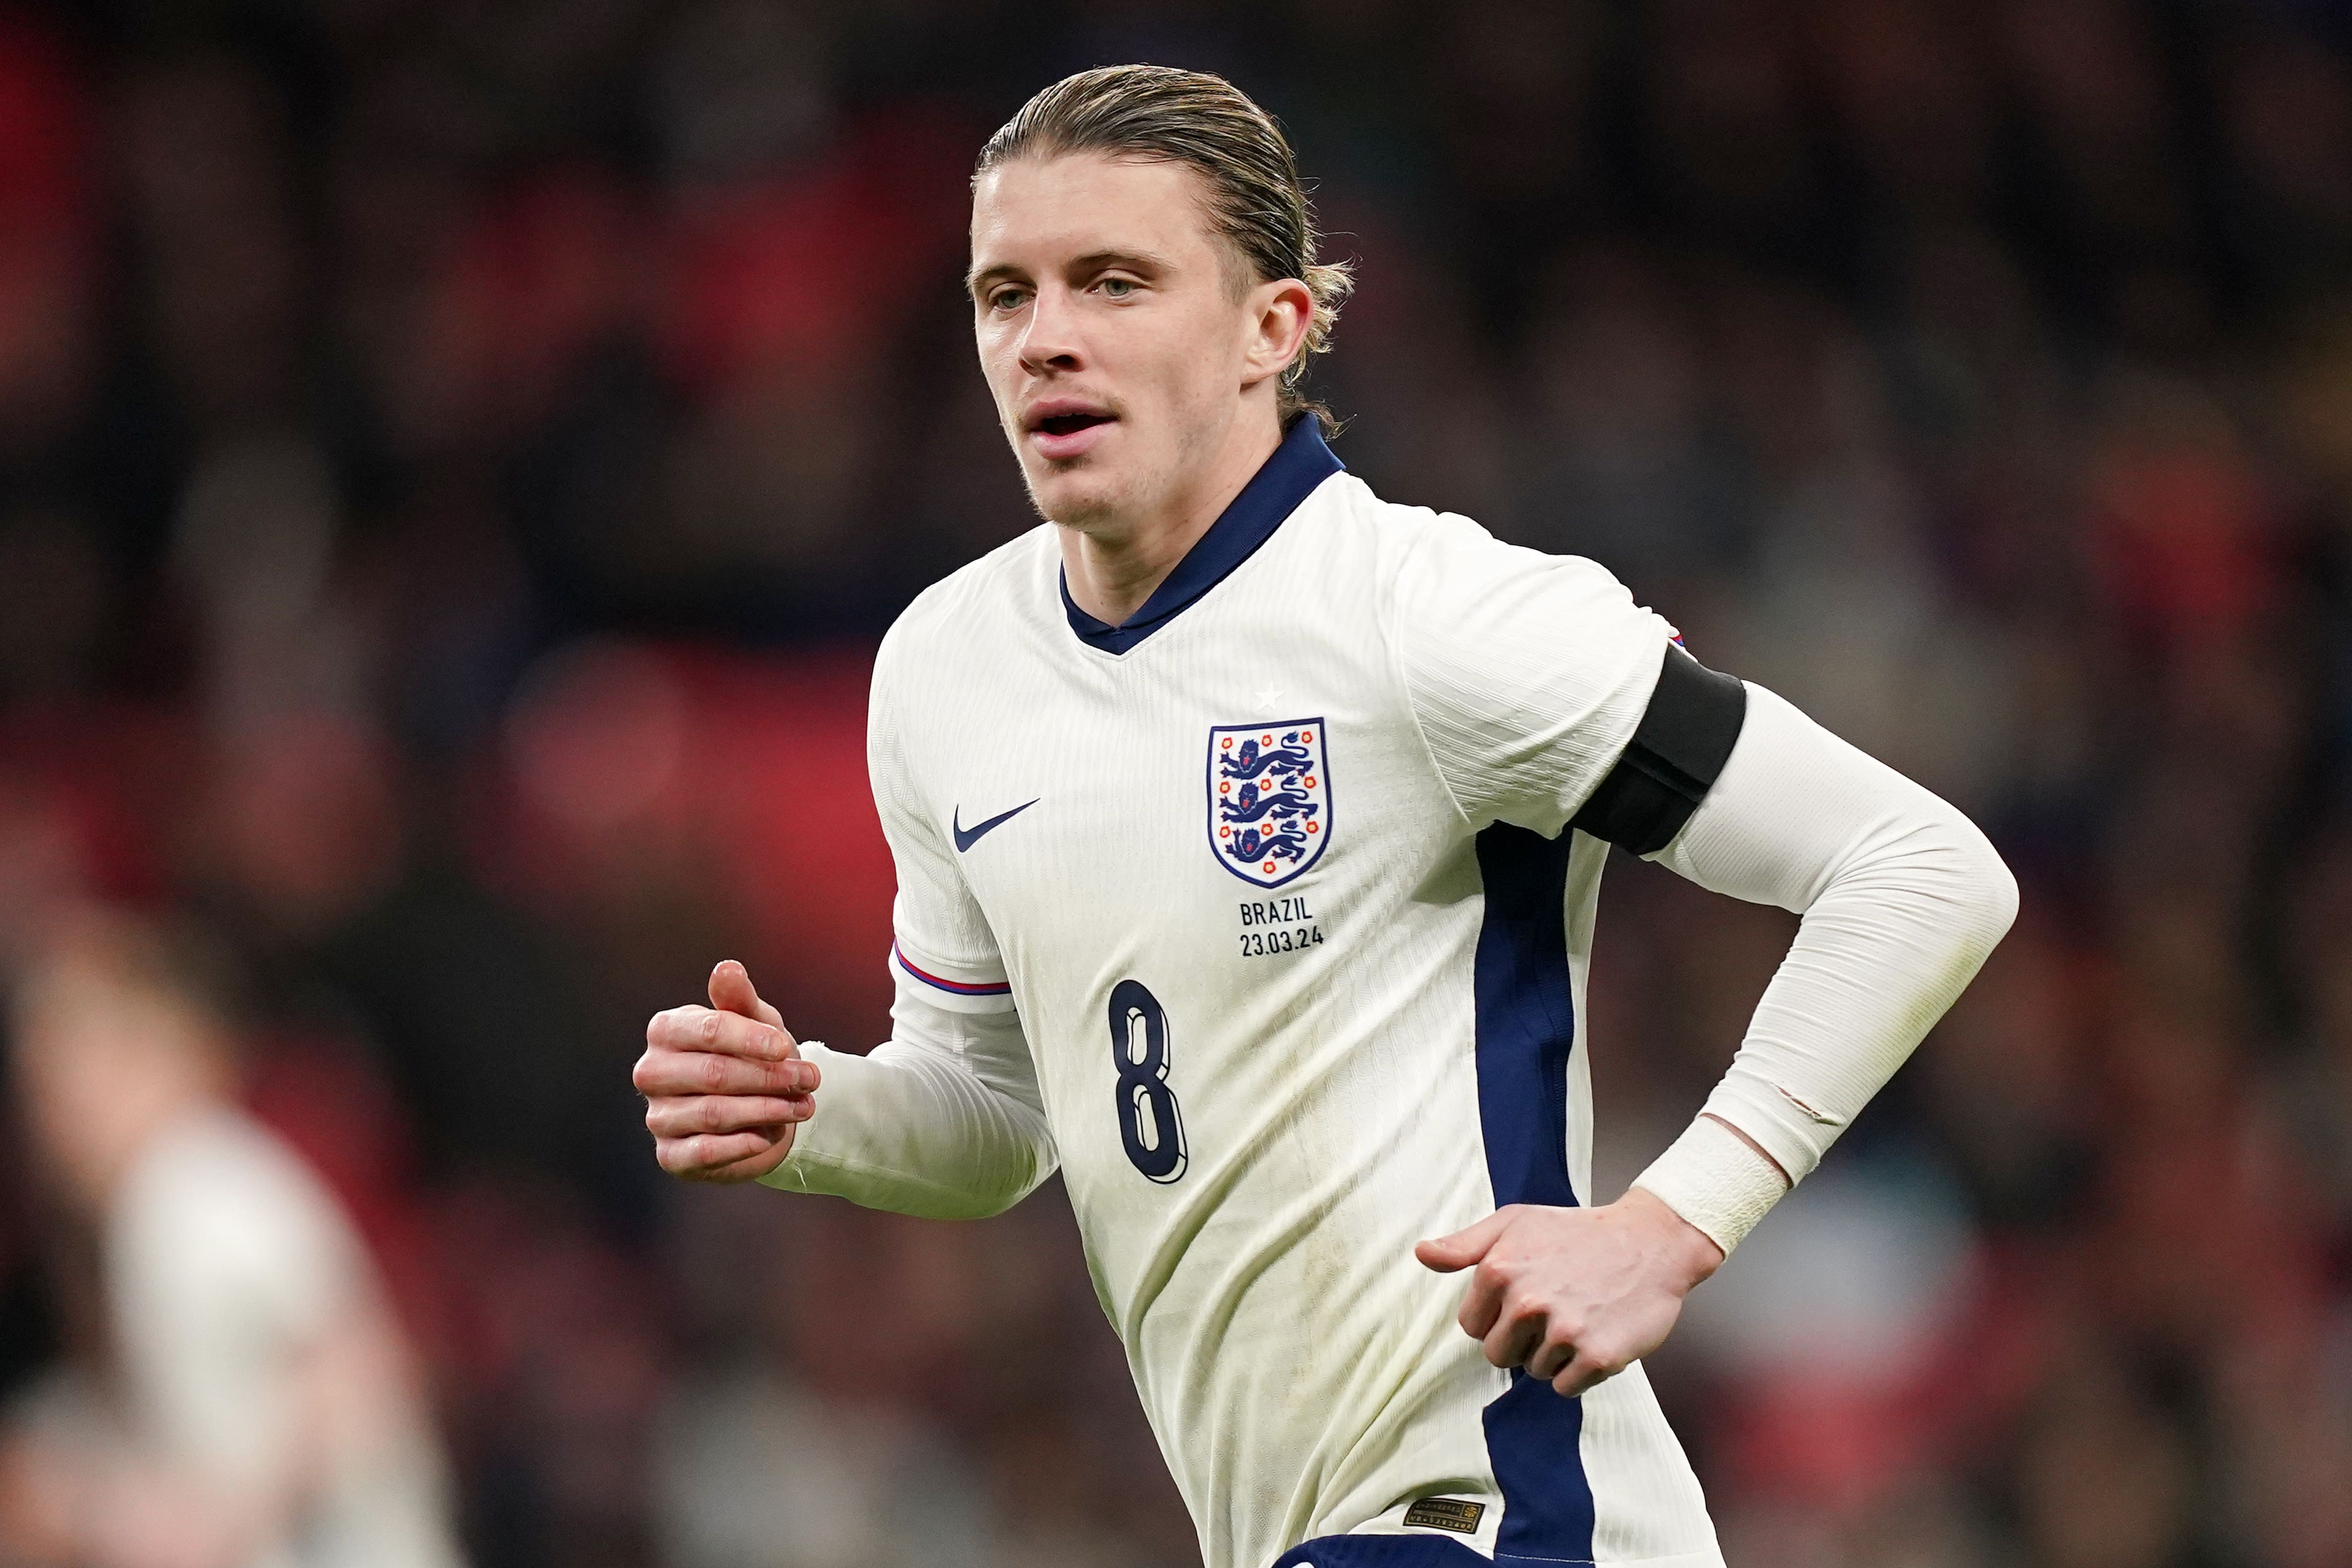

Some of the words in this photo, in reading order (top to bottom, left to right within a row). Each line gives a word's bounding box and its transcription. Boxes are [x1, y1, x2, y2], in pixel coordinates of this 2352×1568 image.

[1240, 897, 1312, 926] BRAZIL
[1240, 926, 1323, 957] 23.03.24
[1109, 979, 1188, 1185] 8
